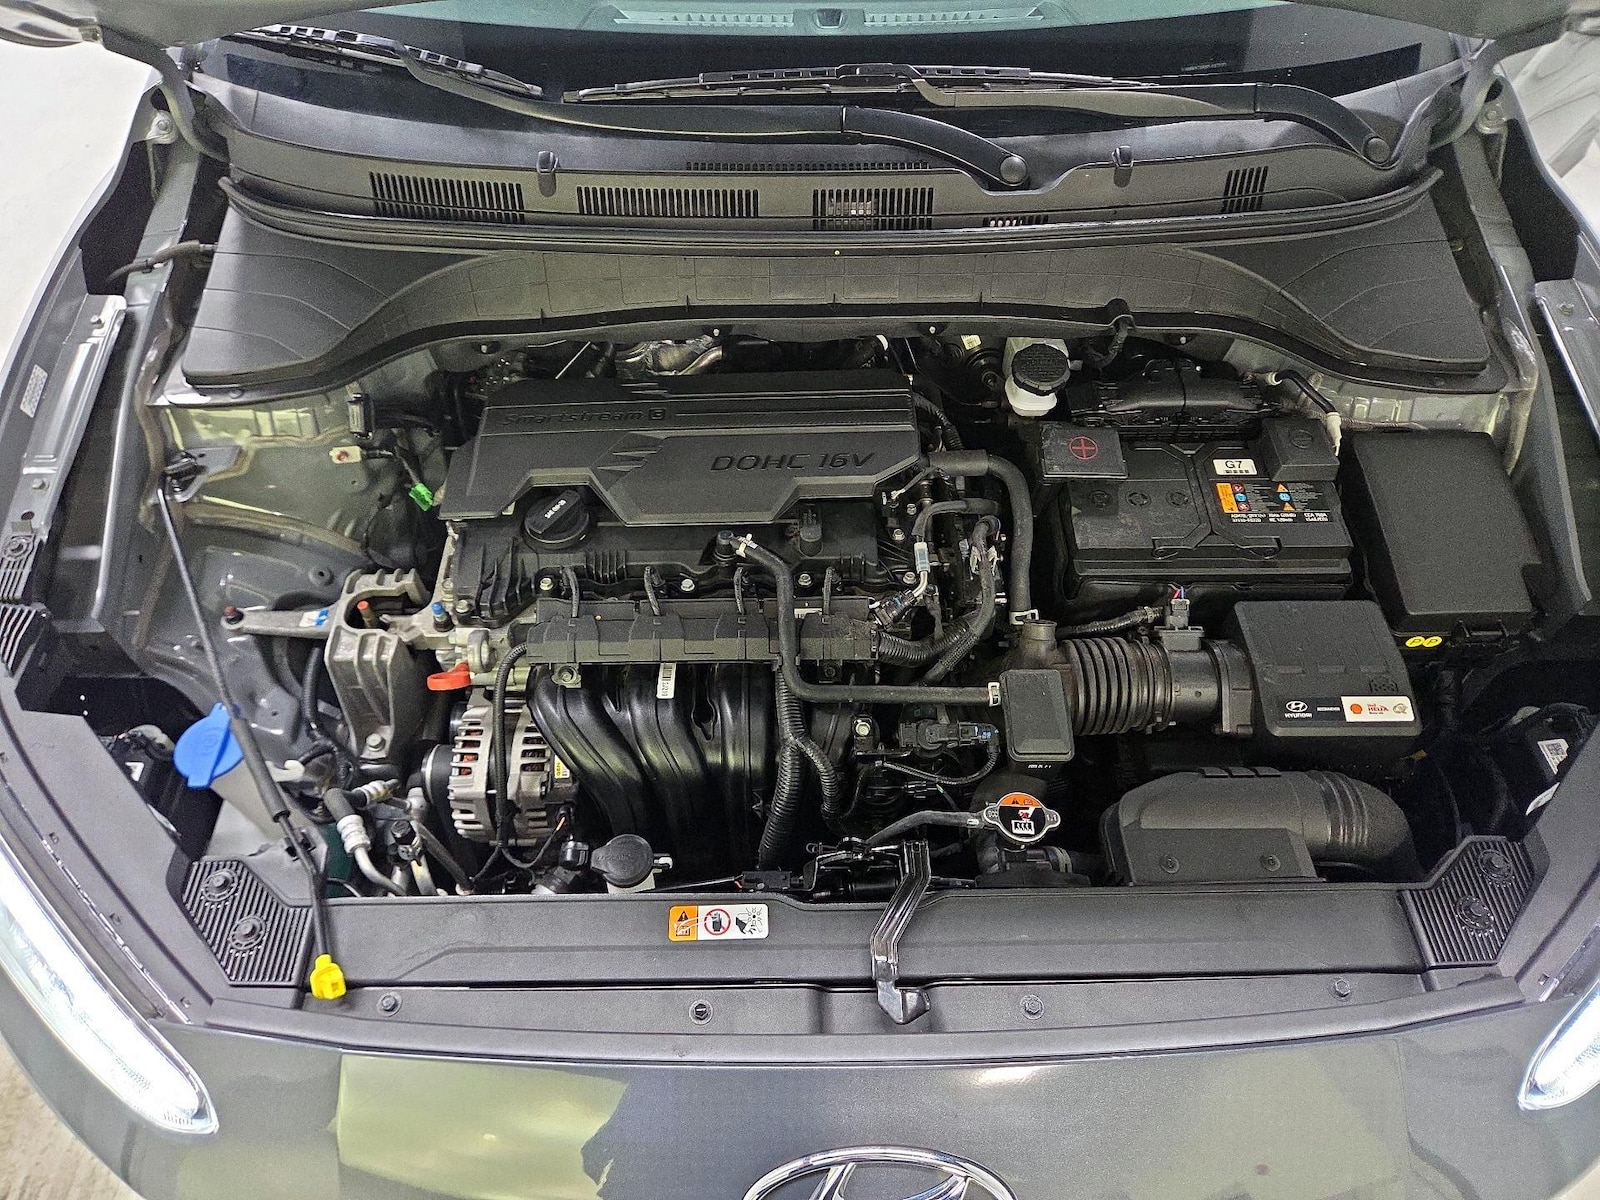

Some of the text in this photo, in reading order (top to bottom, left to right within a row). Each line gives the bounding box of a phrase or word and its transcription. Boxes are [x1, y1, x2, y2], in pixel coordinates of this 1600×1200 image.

[502, 409, 644, 425] Smartstream
[709, 452, 876, 471] DOHC 16V
[1225, 460, 1242, 469] G7
